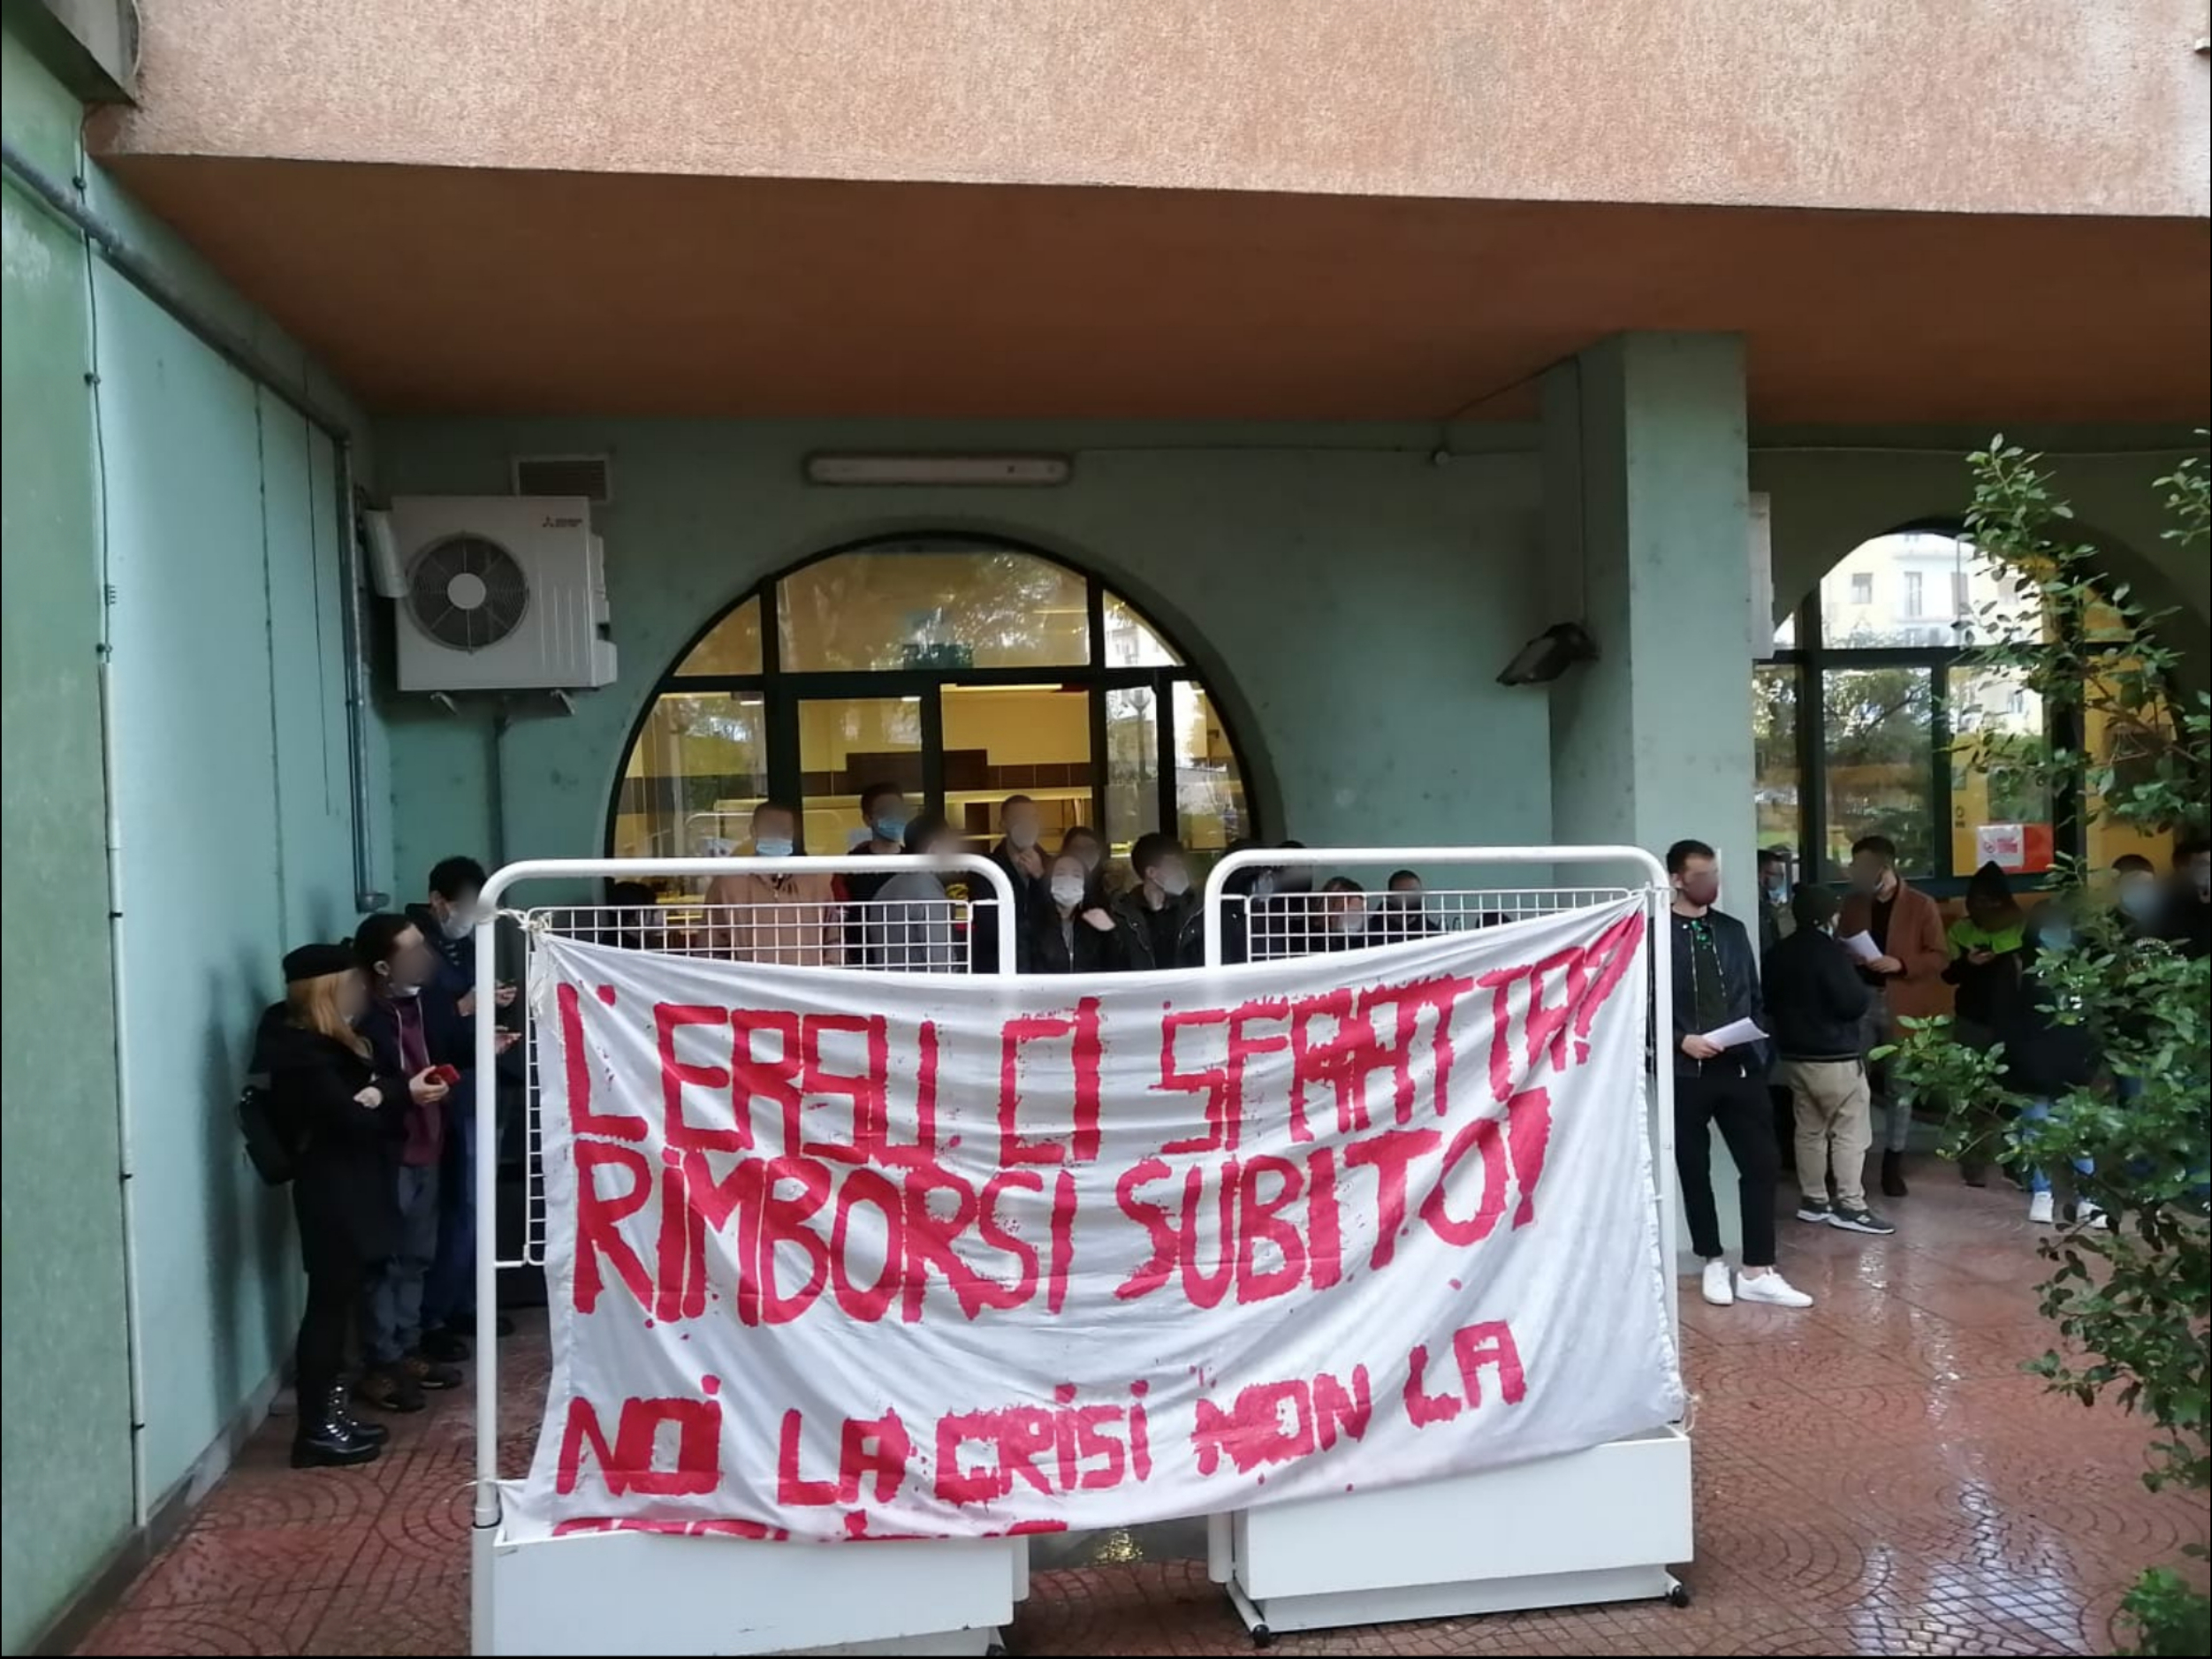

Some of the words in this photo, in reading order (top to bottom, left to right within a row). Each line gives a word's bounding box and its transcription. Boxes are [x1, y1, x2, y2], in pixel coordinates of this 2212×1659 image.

[998, 997, 1103, 1166] CI
[573, 1138, 1076, 1327] RIMBORSI
[1114, 1086, 1552, 1309] SUBITO!
[556, 1375, 722, 1498] NOI
[778, 1409, 912, 1507] LA
[934, 1380, 1152, 1510] CRISI
[1190, 1363, 1372, 1476] NON
[1403, 1320, 1528, 1429] LA
